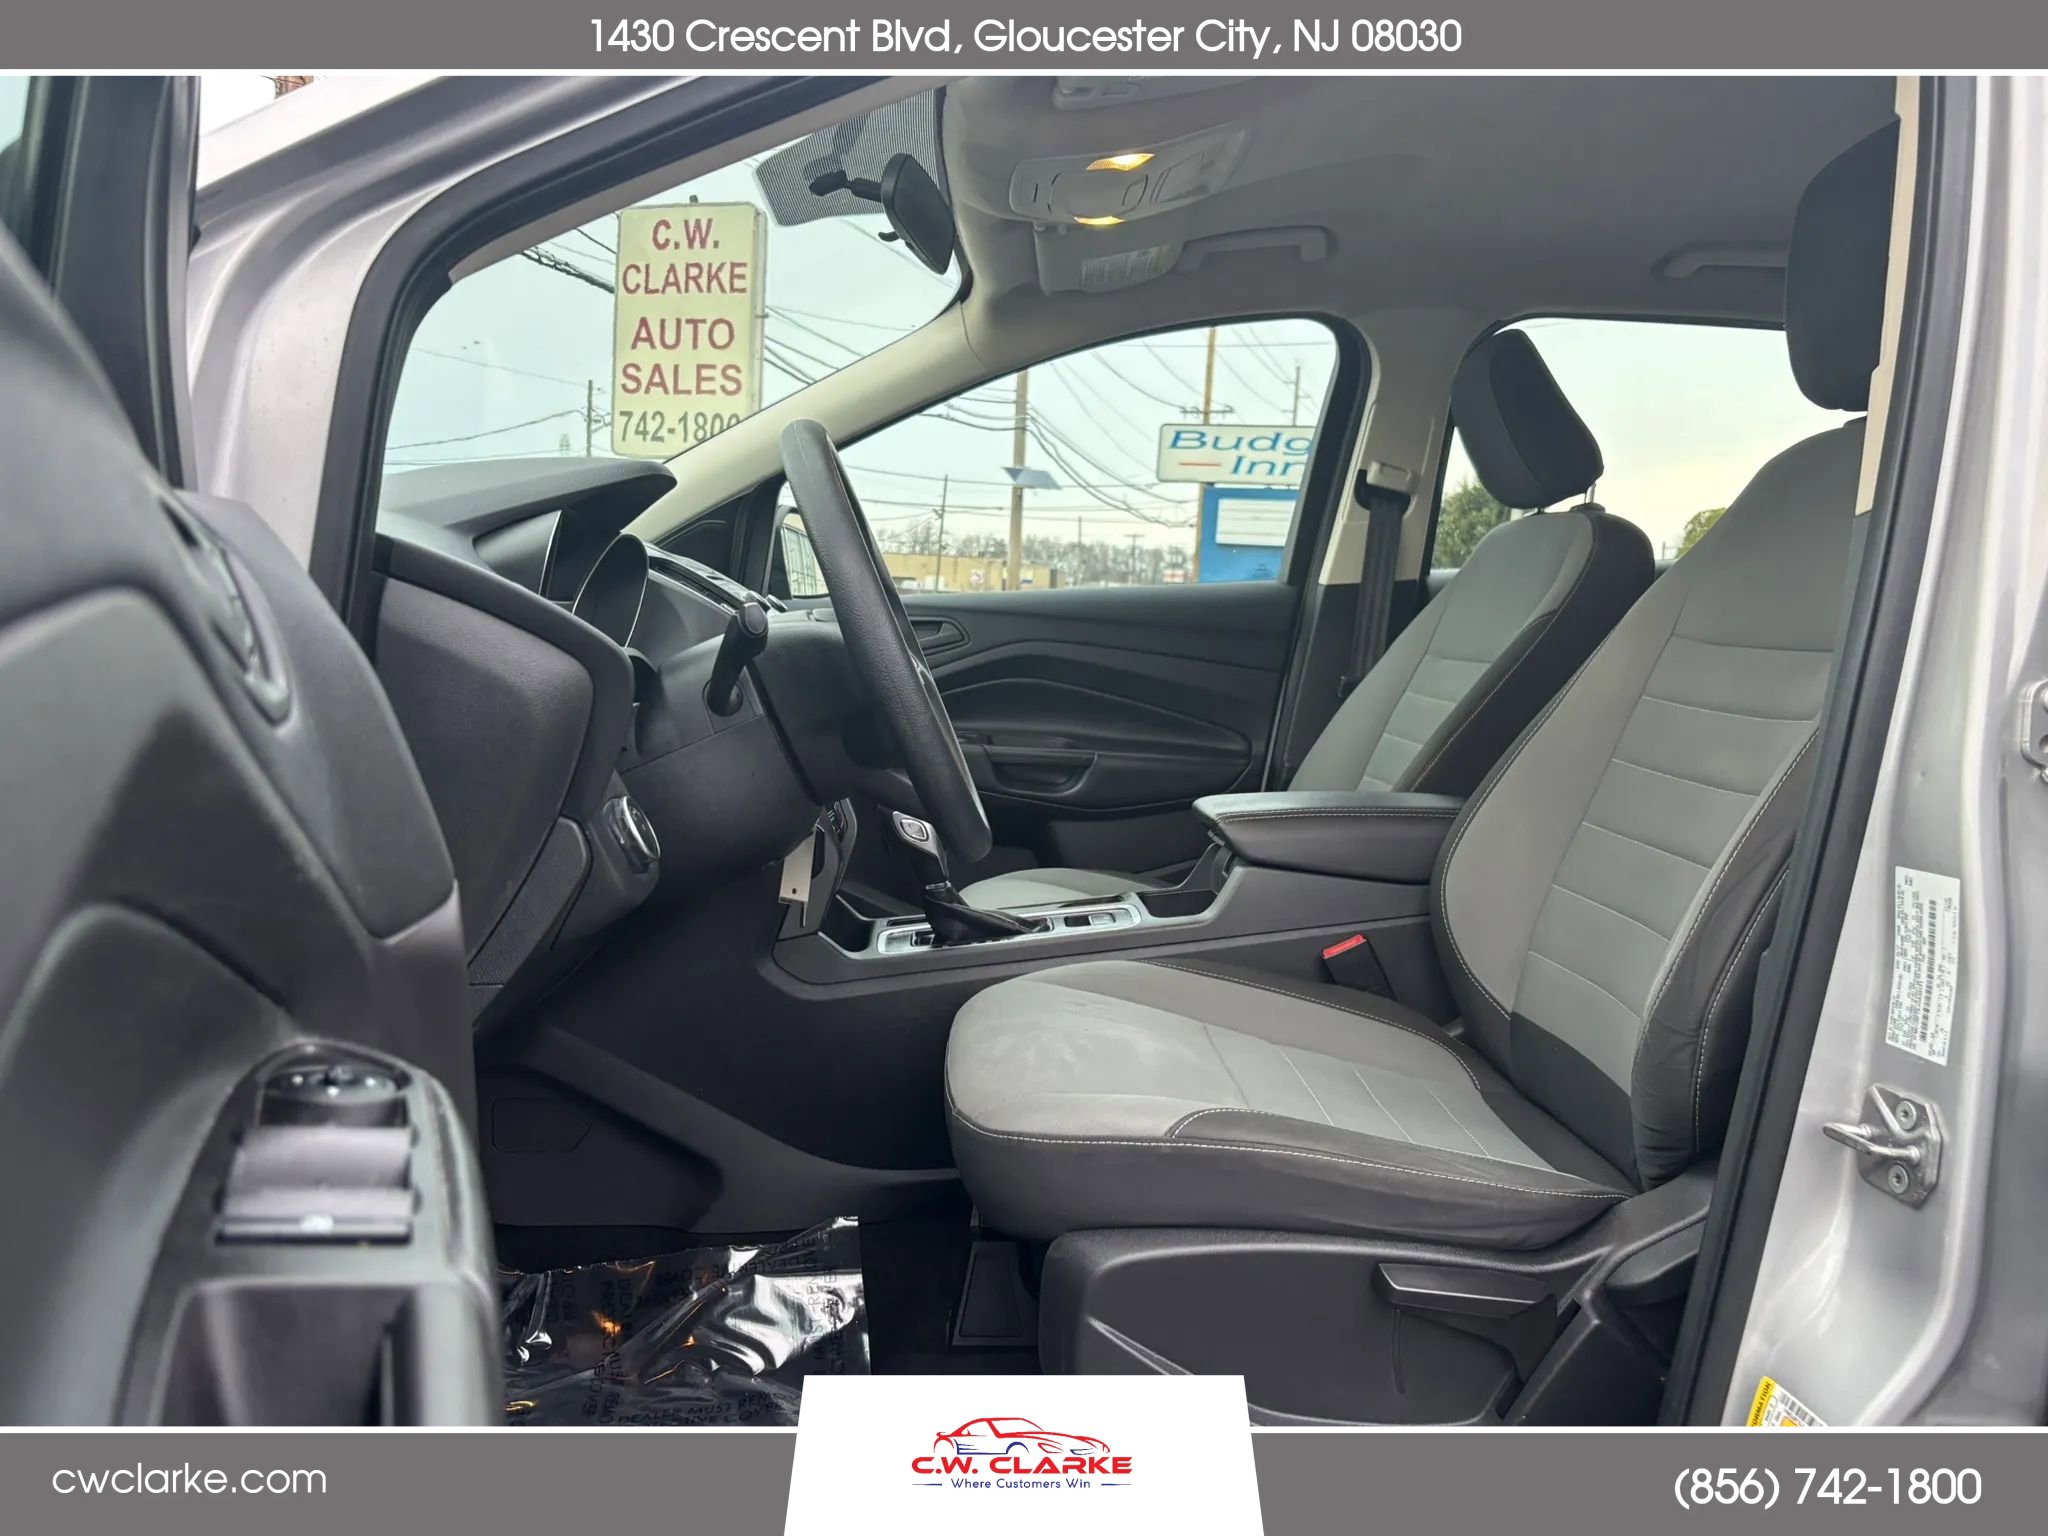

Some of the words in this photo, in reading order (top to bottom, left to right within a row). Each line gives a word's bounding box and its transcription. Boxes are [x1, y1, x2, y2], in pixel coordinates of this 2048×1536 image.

[652, 218, 720, 251] C.W.
[622, 262, 748, 295] CLARKE
[631, 316, 736, 350] AUTO
[621, 363, 743, 395] SALES
[1169, 430, 1313, 456] Budg
[1752, 1382, 1771, 1426] ORMATION
